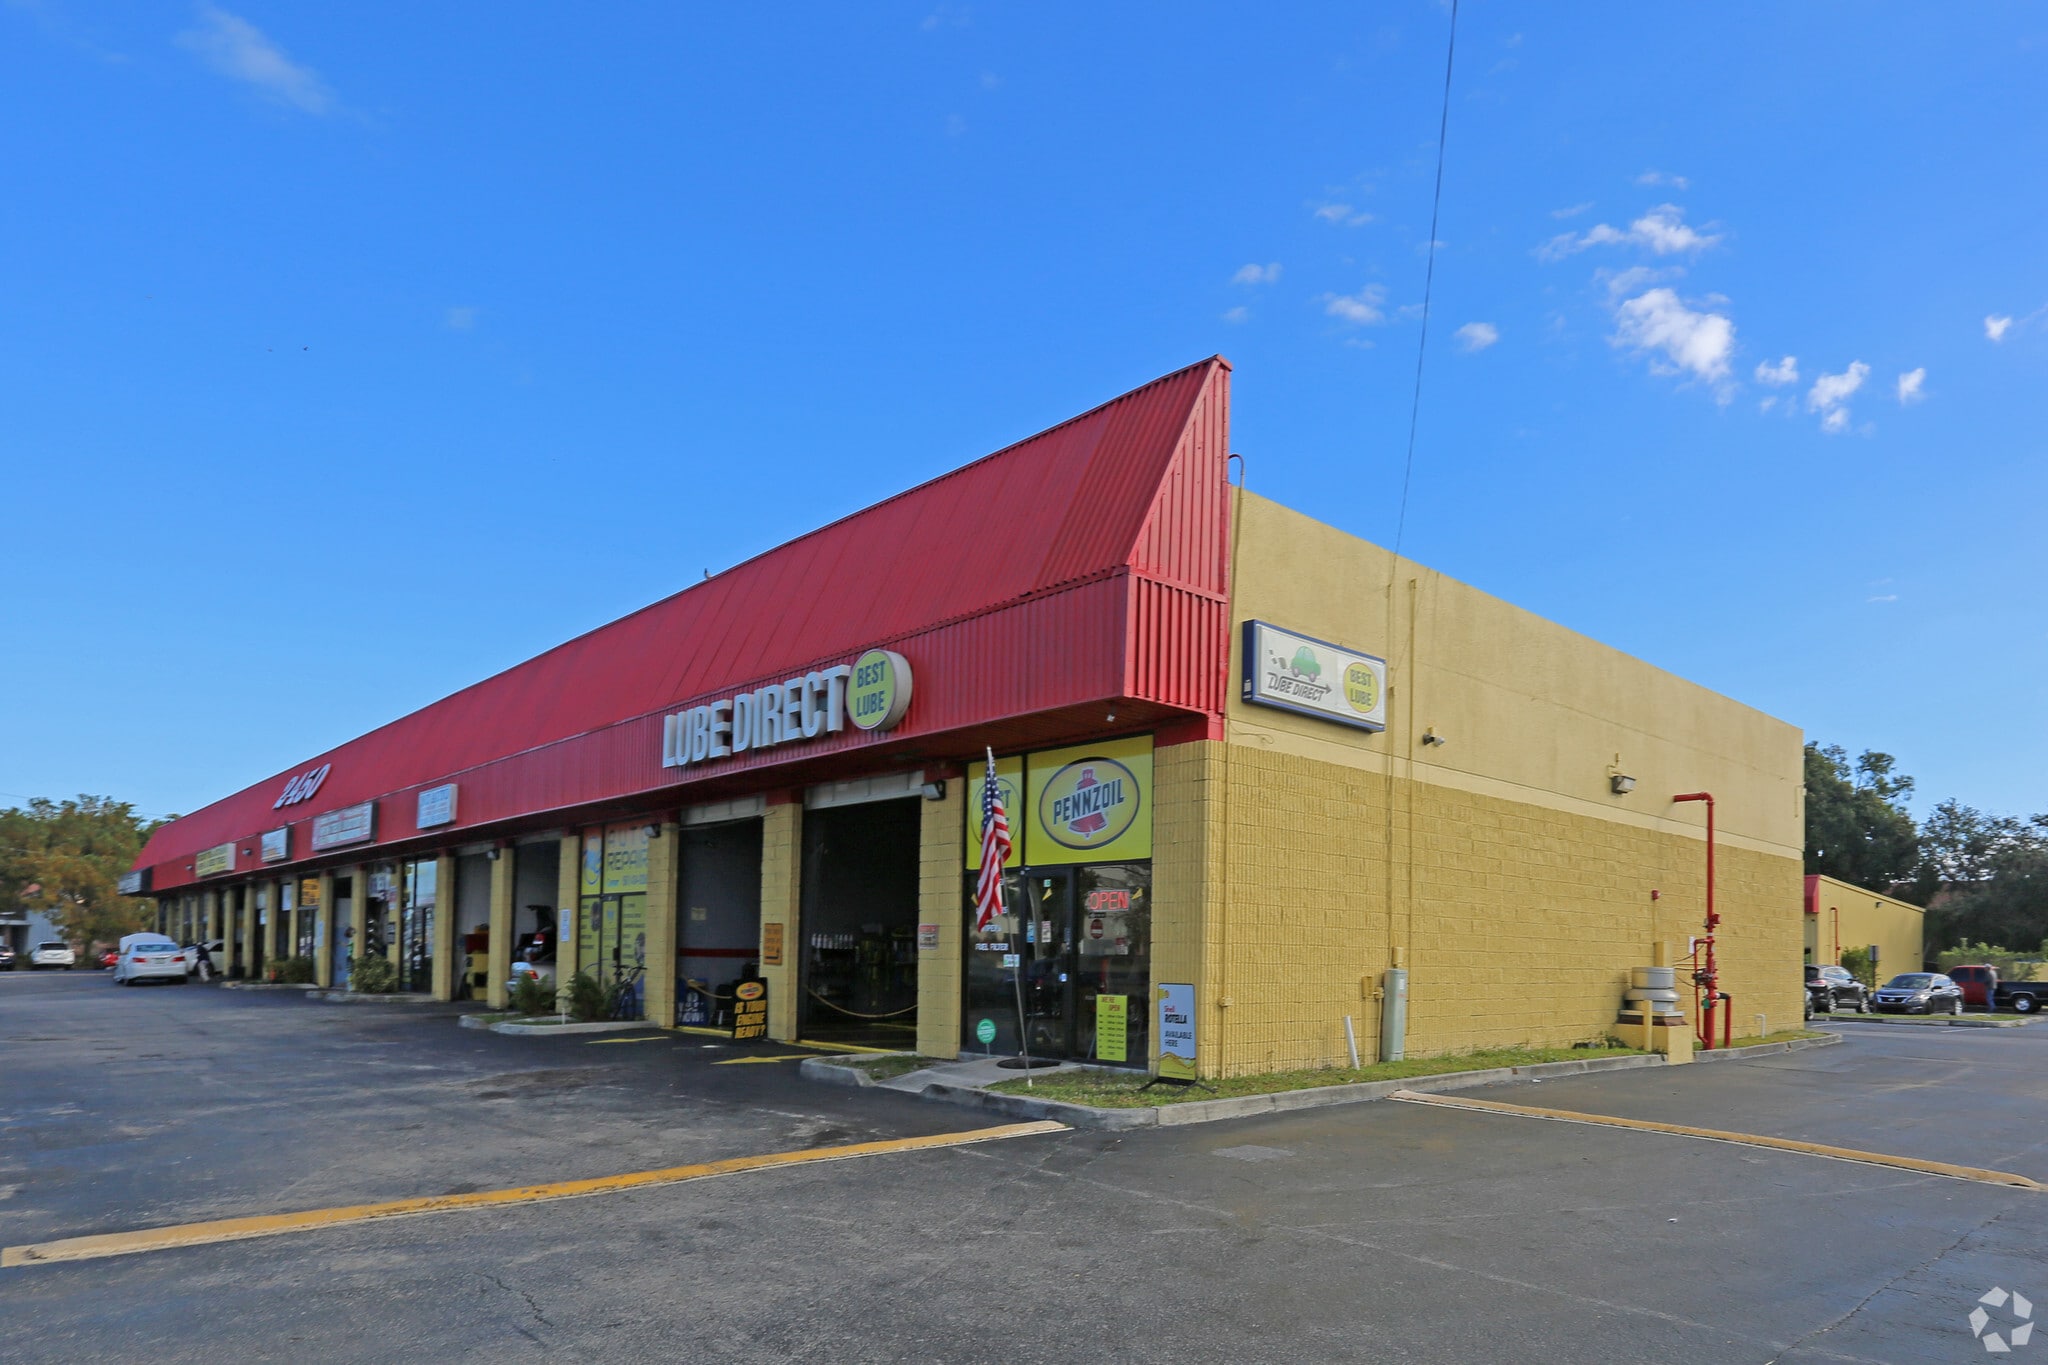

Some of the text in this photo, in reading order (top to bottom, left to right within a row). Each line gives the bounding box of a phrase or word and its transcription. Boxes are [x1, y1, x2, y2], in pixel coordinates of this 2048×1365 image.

[857, 660, 885, 688] BEST
[1350, 669, 1372, 688] BEST
[1267, 672, 1292, 695] LUBE
[1292, 683, 1324, 702] DIRECT
[1350, 688, 1372, 707] LUBE
[856, 690, 885, 717] LUBE
[662, 664, 851, 768] LUBE DIRECT
[272, 763, 332, 810] 2450
[1053, 778, 1125, 825] PENNZOIL
[1090, 892, 1129, 910] OPEN
[1164, 1013, 1188, 1024] ROTELLA
[1165, 1030, 1193, 1040] AVAILABLE
[1165, 1039, 1179, 1047] HERE
